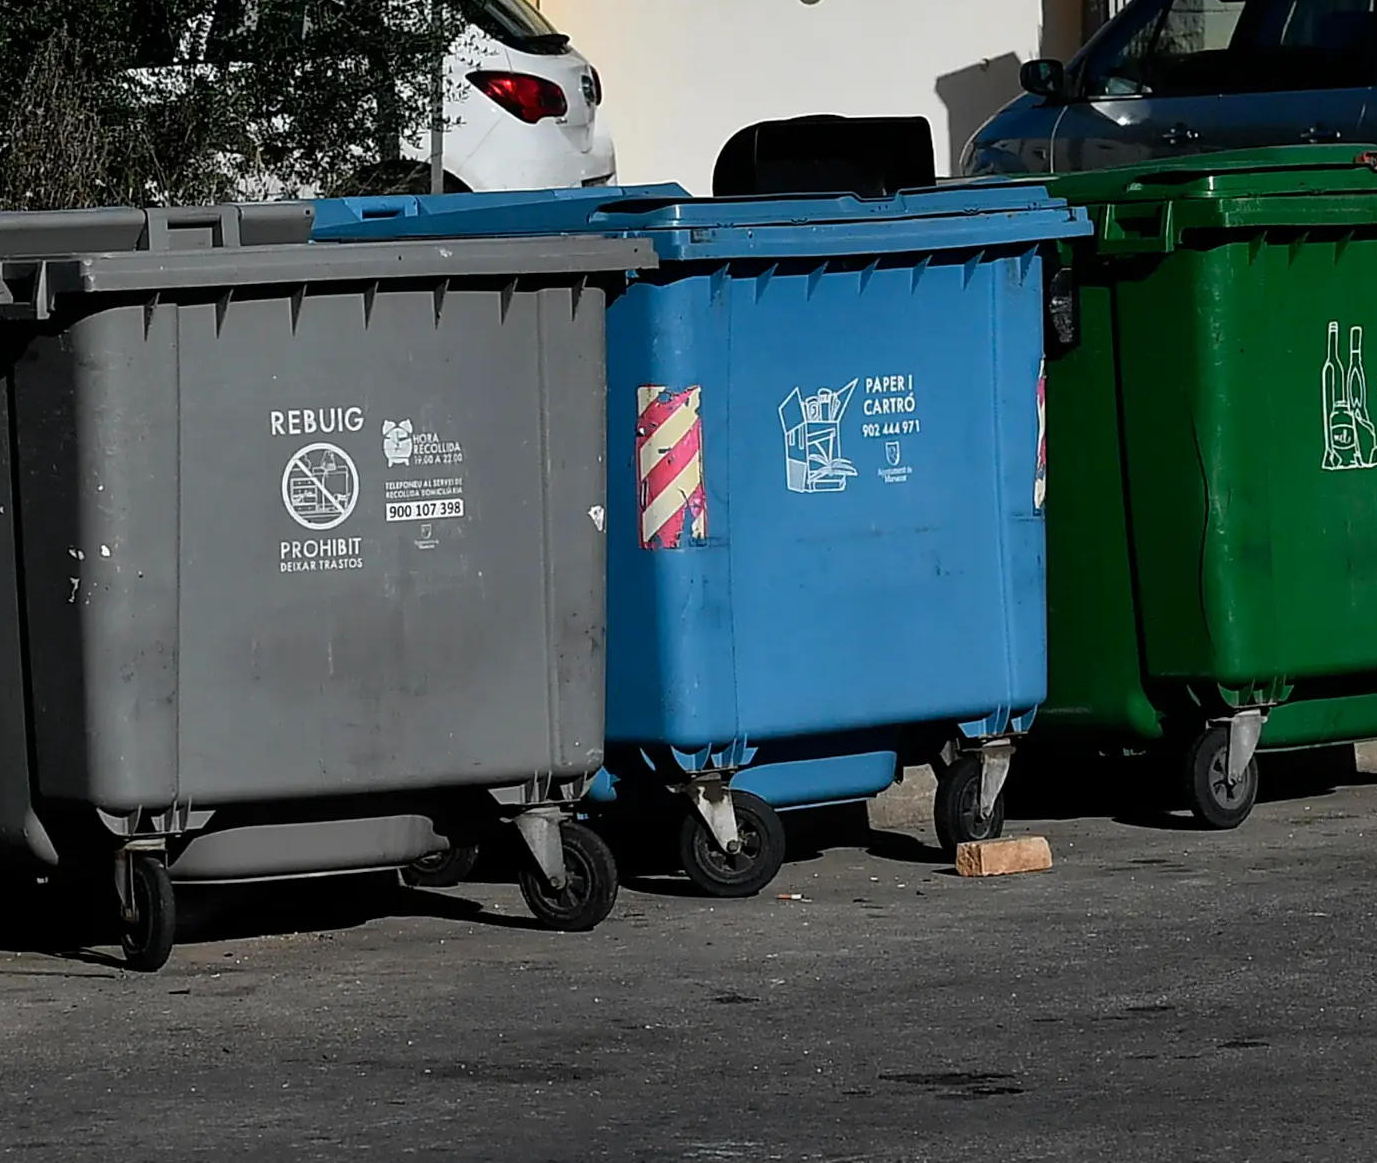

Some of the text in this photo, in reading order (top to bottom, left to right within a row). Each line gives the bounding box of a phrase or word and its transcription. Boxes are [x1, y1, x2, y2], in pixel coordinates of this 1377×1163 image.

[866, 374, 913, 394] PAPER I
[863, 392, 915, 416] CARTRÓ
[270, 407, 364, 435] REBUIG
[862, 419, 920, 437] 902 444 971
[413, 433, 440, 444] HORA
[413, 442, 461, 454] RECOLLIDA
[435, 454, 441, 463] A
[389, 501, 461, 518] 900 107 398
[280, 538, 362, 559] PROHIBIT
[280, 558, 363, 572] DEIXAR TRASTOS
